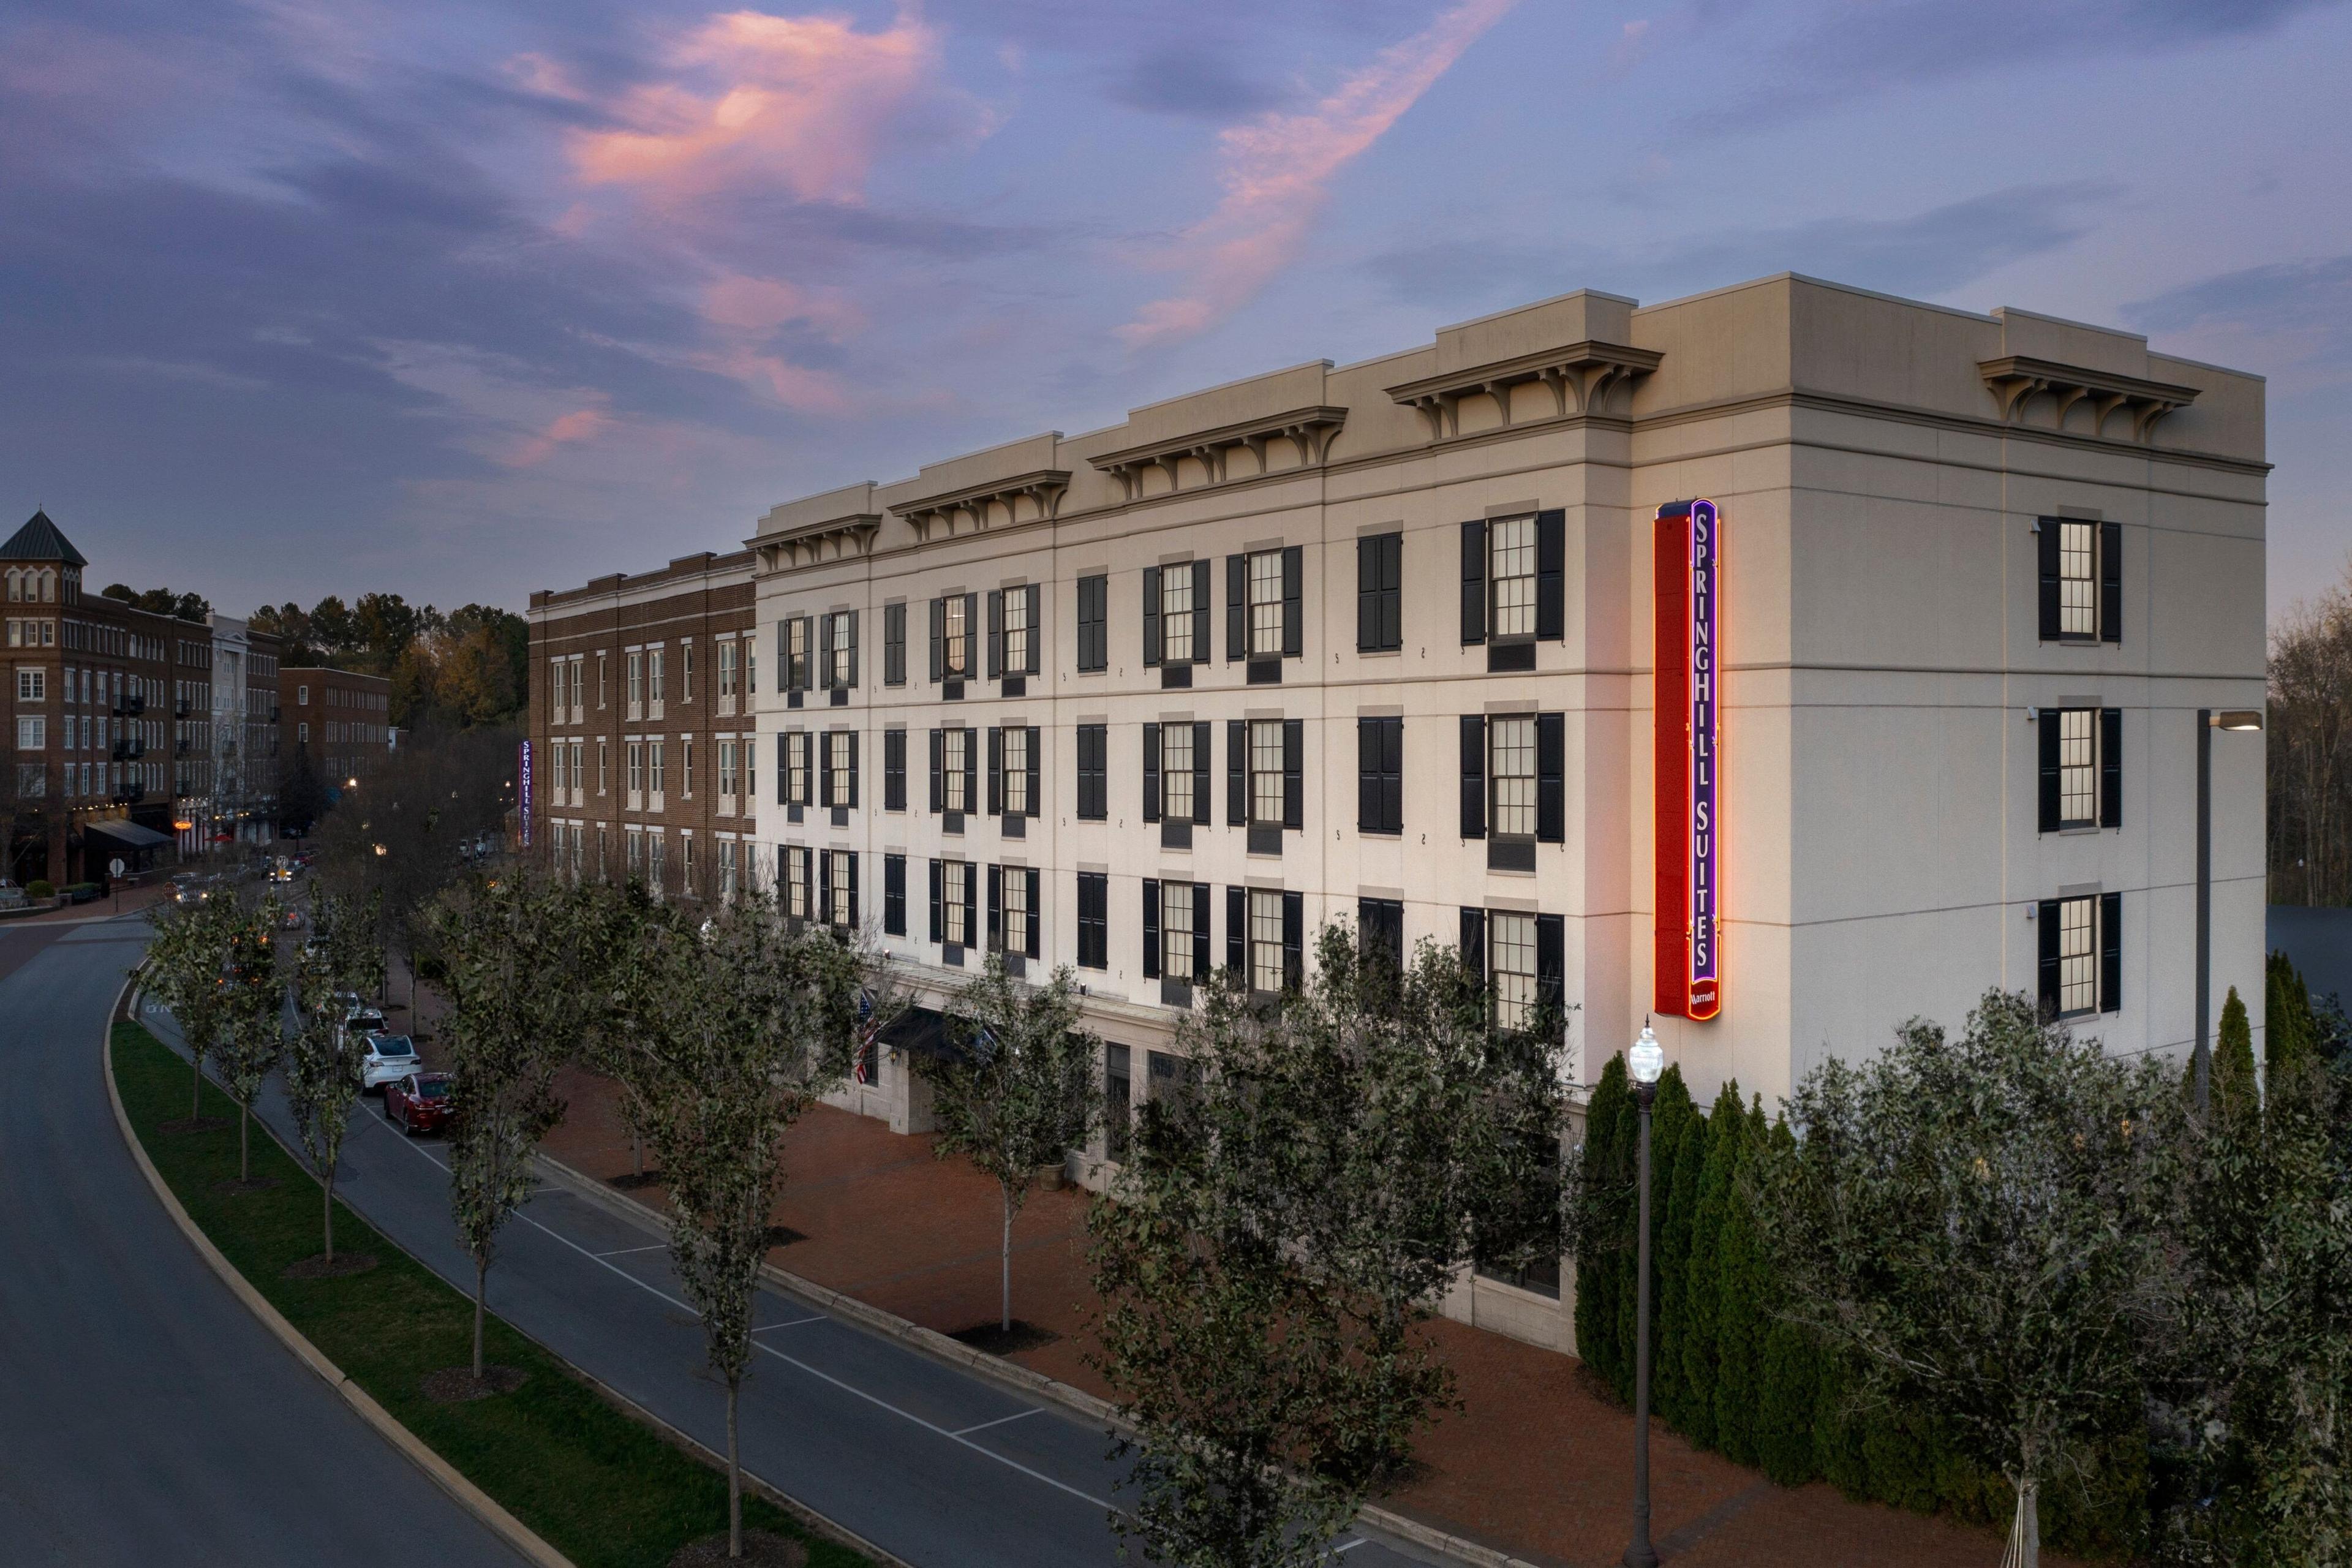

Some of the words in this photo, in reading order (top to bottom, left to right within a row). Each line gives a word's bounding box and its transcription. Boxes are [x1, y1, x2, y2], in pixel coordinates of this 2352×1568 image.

[1694, 513, 1709, 785] SPRINGHILL
[1696, 801, 1708, 967] SUITES
[1691, 990, 1716, 1005] Marriott
